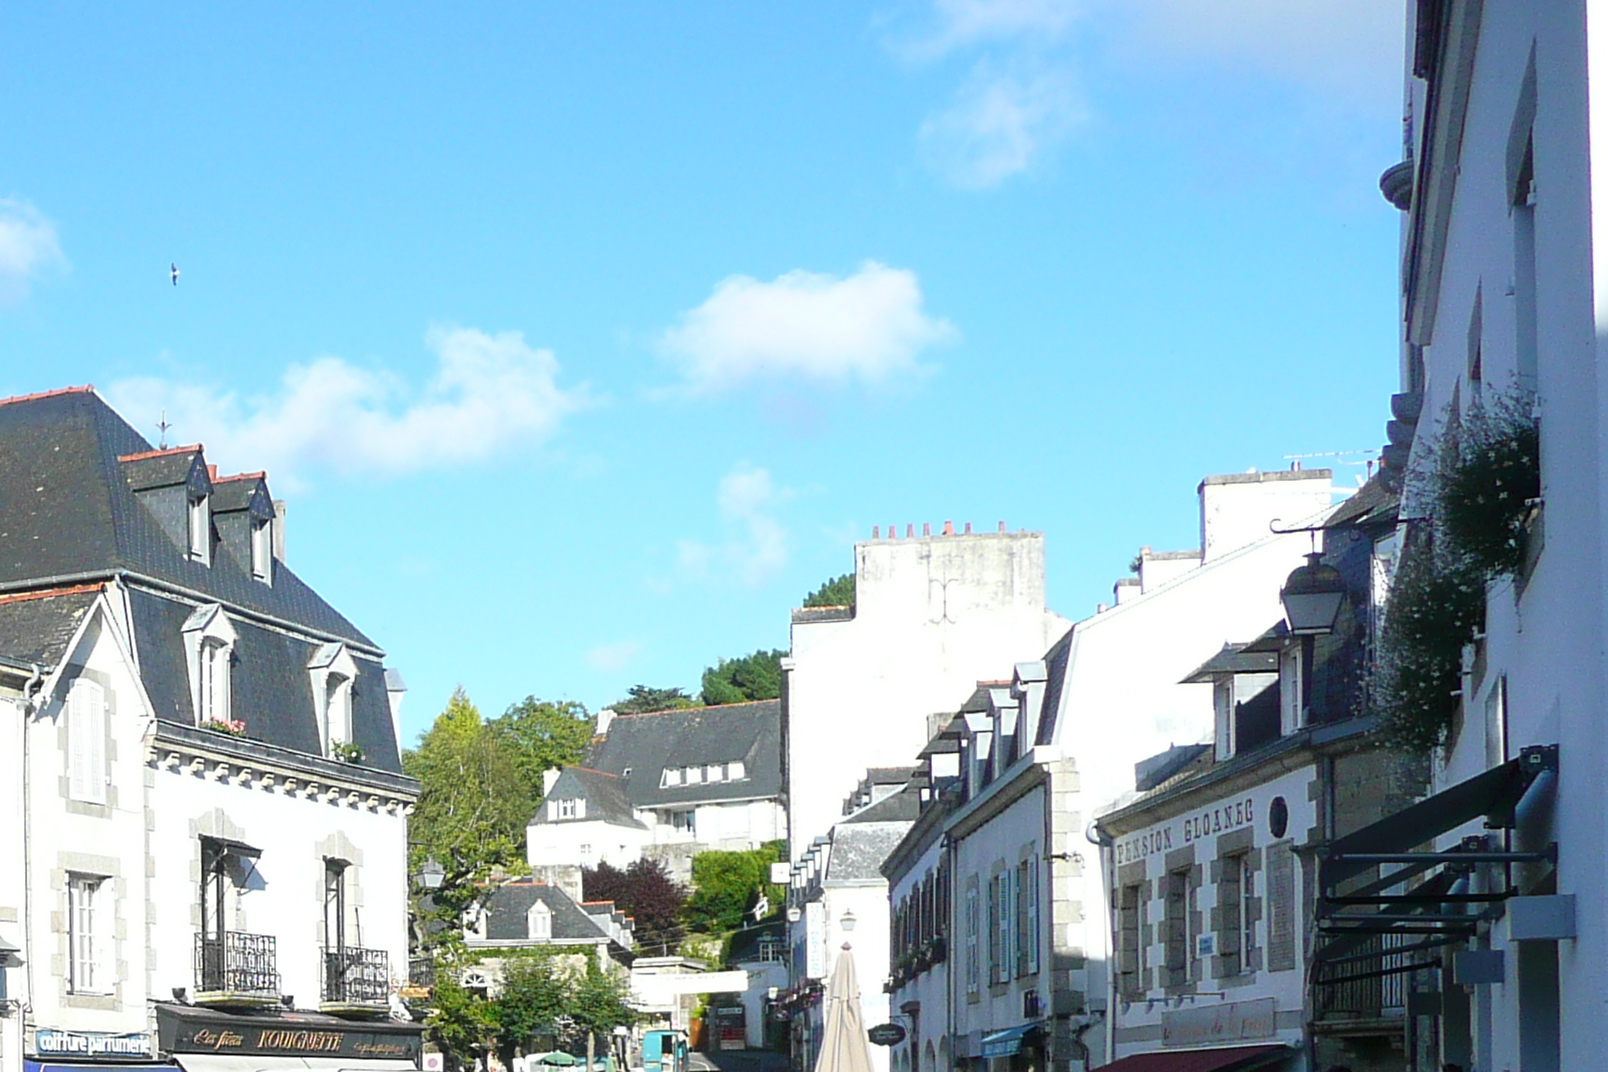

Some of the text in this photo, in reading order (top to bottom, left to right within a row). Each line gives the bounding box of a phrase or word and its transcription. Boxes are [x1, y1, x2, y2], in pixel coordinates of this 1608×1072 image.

[1117, 799, 1253, 864] PENSION GLOANEC
[40, 1032, 151, 1056] coiffure parfumerie
